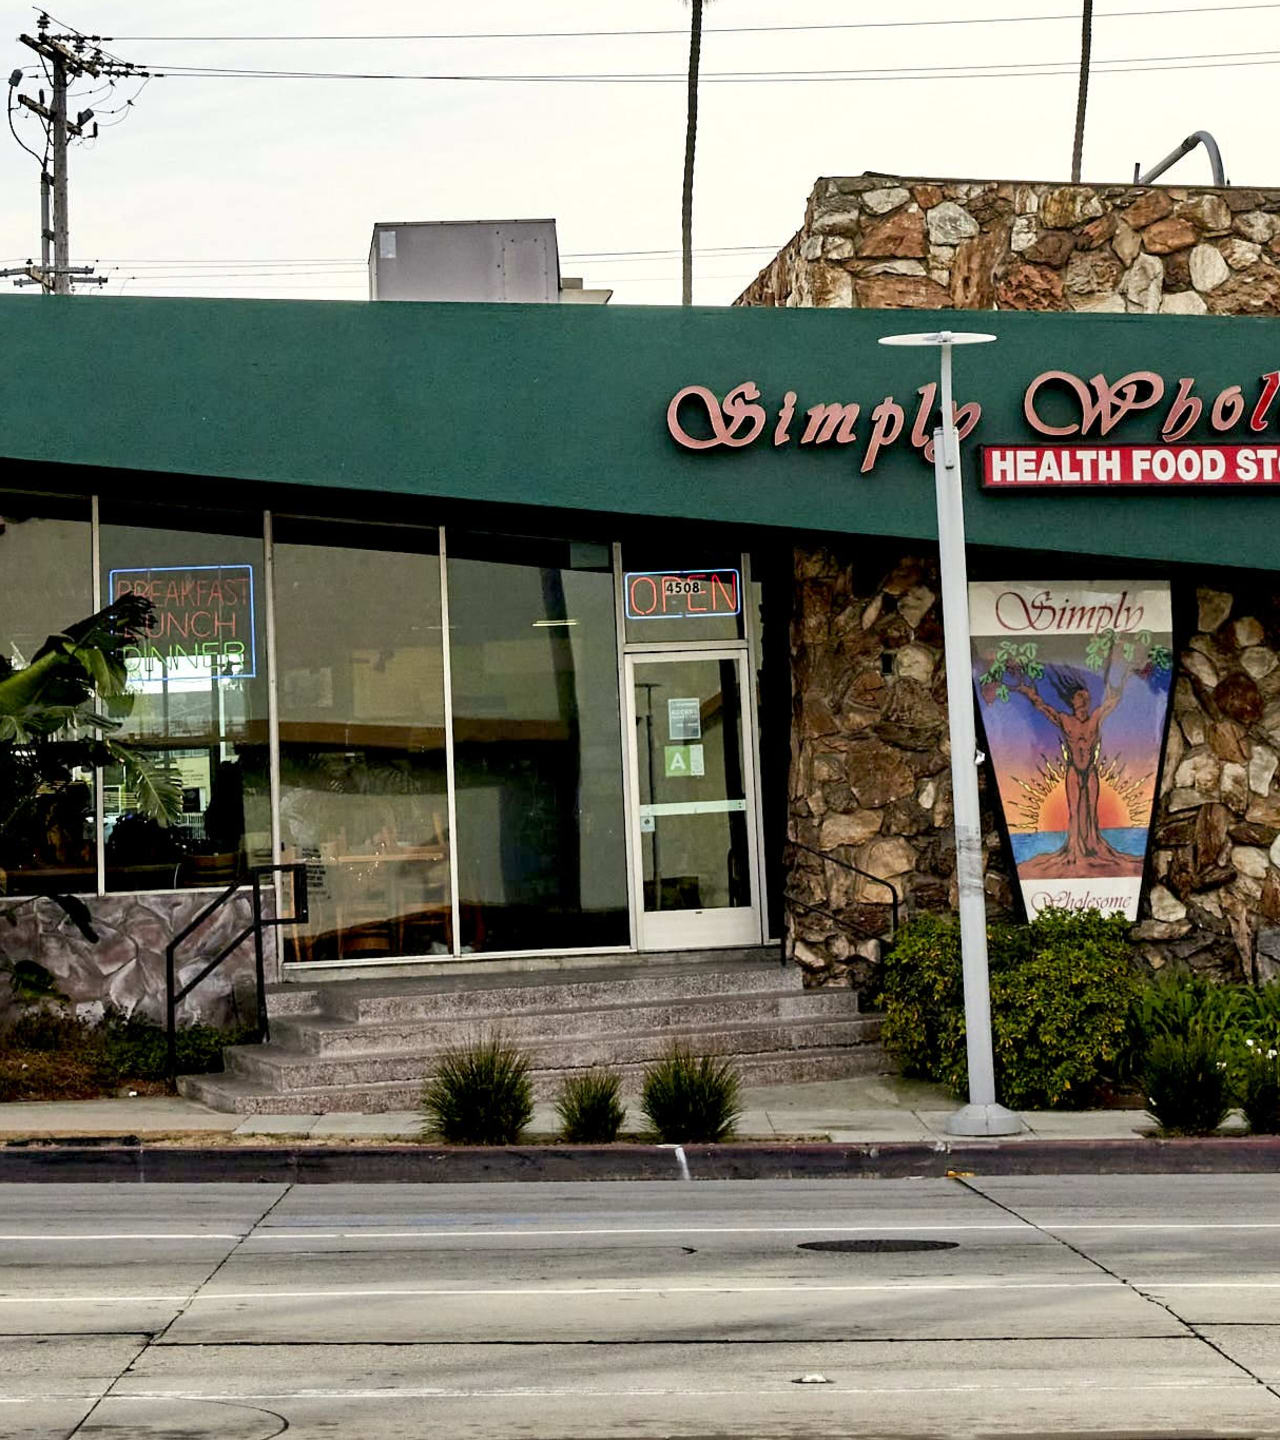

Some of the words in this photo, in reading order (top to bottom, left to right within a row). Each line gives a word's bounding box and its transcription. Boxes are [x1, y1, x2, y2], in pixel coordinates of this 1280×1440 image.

[666, 380, 982, 473] Simply
[991, 448, 1121, 483] HEALTH
[1132, 448, 1223, 482] FOOD
[630, 573, 736, 615] OPEN
[665, 581, 701, 594] 4508
[995, 590, 1145, 636] Simply
[122, 640, 246, 673] DINNER
[670, 751, 687, 771] A
